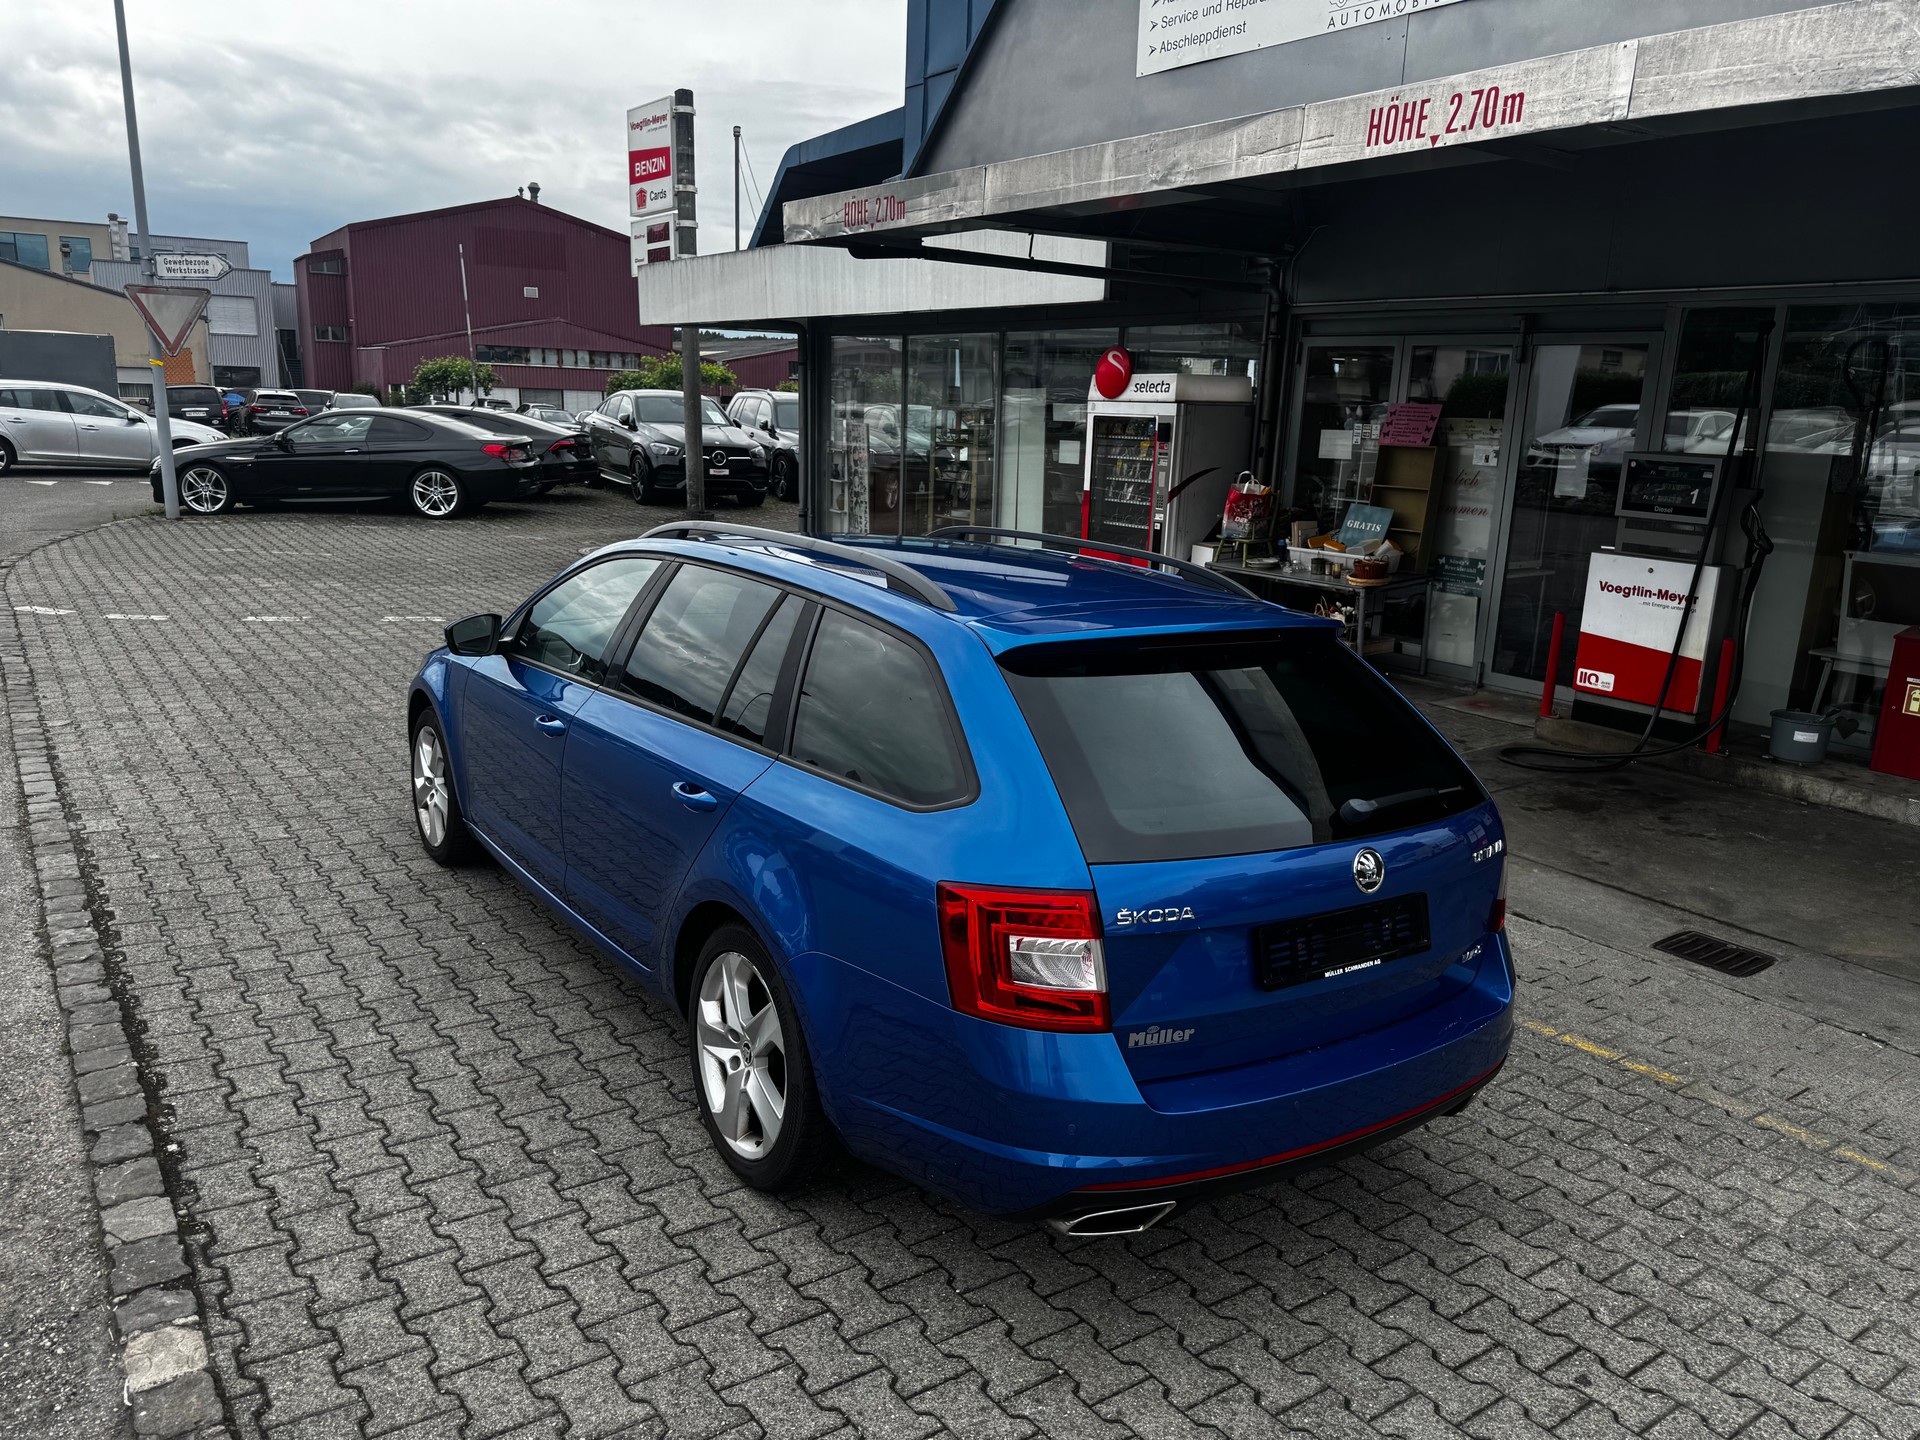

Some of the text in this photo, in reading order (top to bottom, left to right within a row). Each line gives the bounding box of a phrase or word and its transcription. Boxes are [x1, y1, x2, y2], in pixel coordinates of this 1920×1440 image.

[1161, 9, 1199, 29] Service
[1202, 0, 1222, 17] und
[1159, 21, 1247, 54] Abschleppdienst
[1366, 95, 1432, 148] HÖHE
[635, 155, 666, 177] BENZIN
[649, 188, 667, 201] Cards
[844, 195, 869, 228] HÖHE
[163, 257, 210, 266] Gewerbezone
[165, 266, 210, 275] Werkstrasse
[1133, 380, 1171, 393] selecta
[1689, 488, 1699, 505] 1
[1653, 505, 1674, 513] Diesel
[1346, 519, 1382, 533] GRATIS
[1116, 906, 1196, 925] ŠKODA
[1324, 968, 1343, 978] MÜLLER
[1374, 958, 1381, 966] AG
